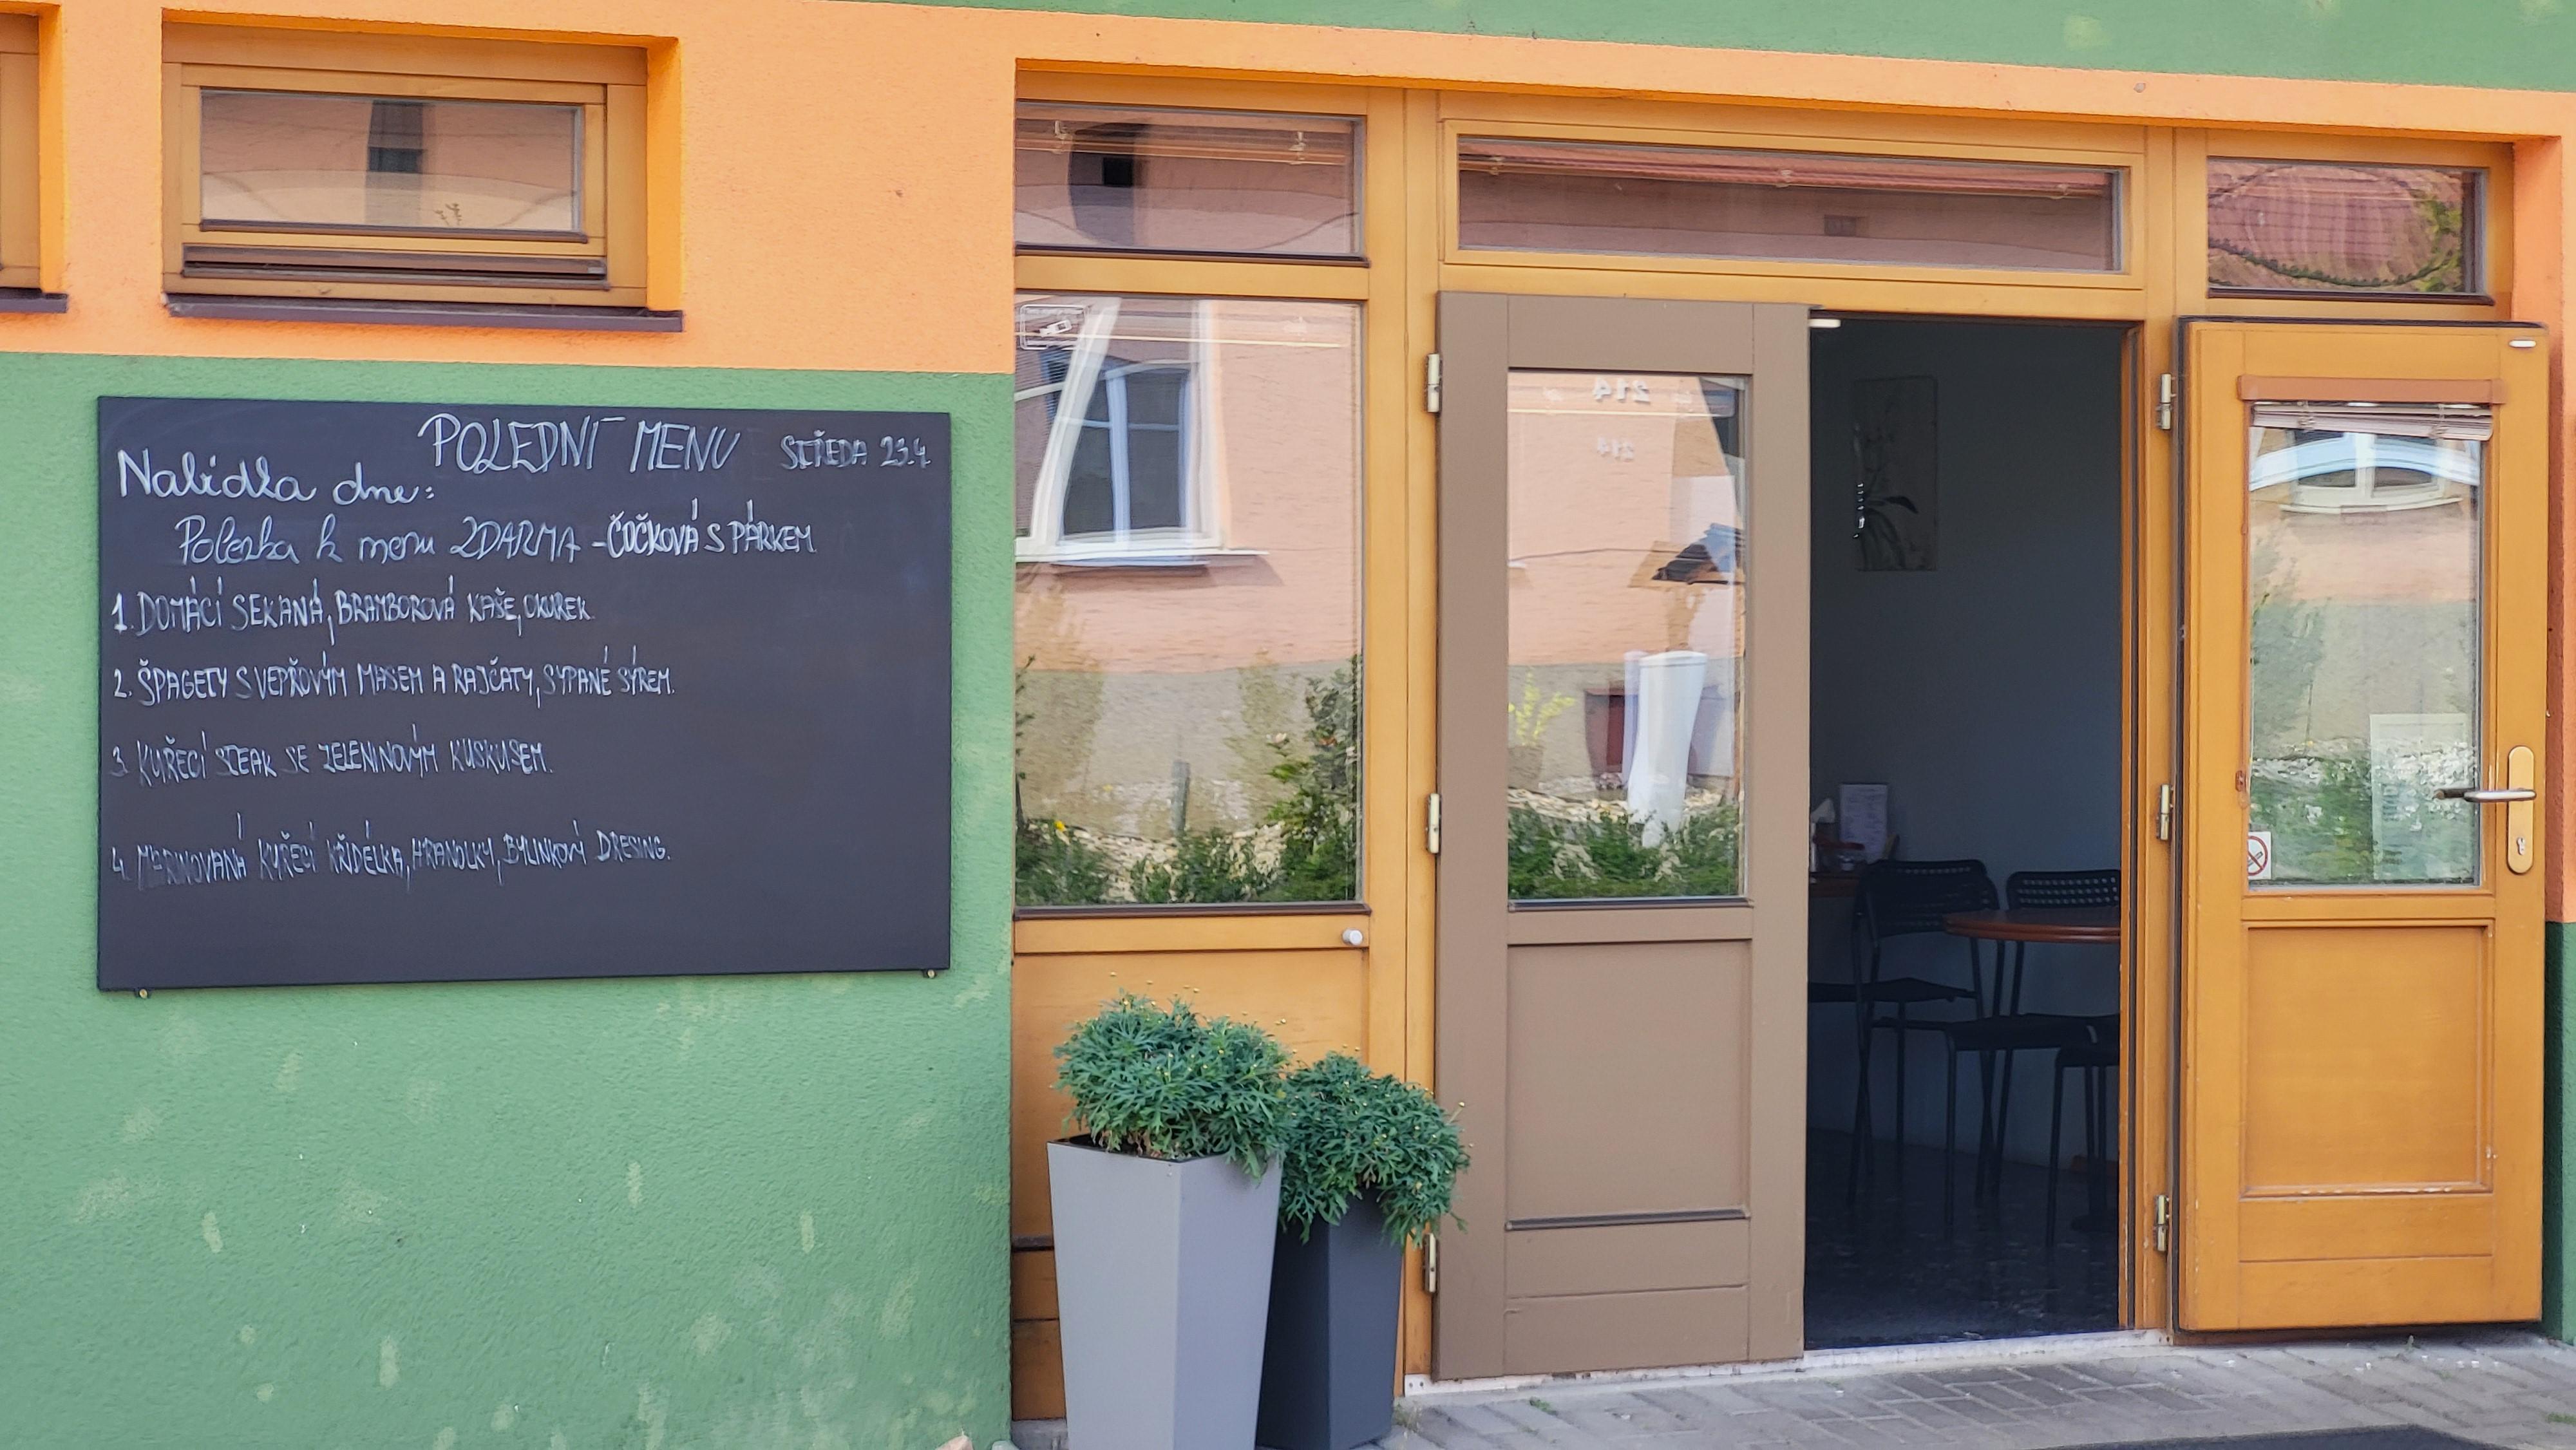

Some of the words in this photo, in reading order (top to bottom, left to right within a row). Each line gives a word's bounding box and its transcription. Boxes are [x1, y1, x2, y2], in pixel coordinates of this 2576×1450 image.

[629, 420, 741, 473] MENU
[316, 513, 343, 563] k
[359, 531, 436, 564] menu
[450, 516, 582, 563] ZDARMA
[703, 523, 725, 552] S
[137, 575, 222, 636] DOMÁCÍ
[335, 574, 455, 625] BRAMBOROVÁ
[137, 658, 227, 706] ŠPAGETY
[236, 666, 252, 699] S
[254, 650, 347, 700] VEPŘOVÝM
[357, 663, 424, 695] MASEM
[432, 664, 446, 694] A
[451, 656, 540, 709] RAJČATY,
[543, 645, 612, 696] SYPANÉ
[214, 744, 278, 777] STEAK
[285, 744, 310, 773] SE
